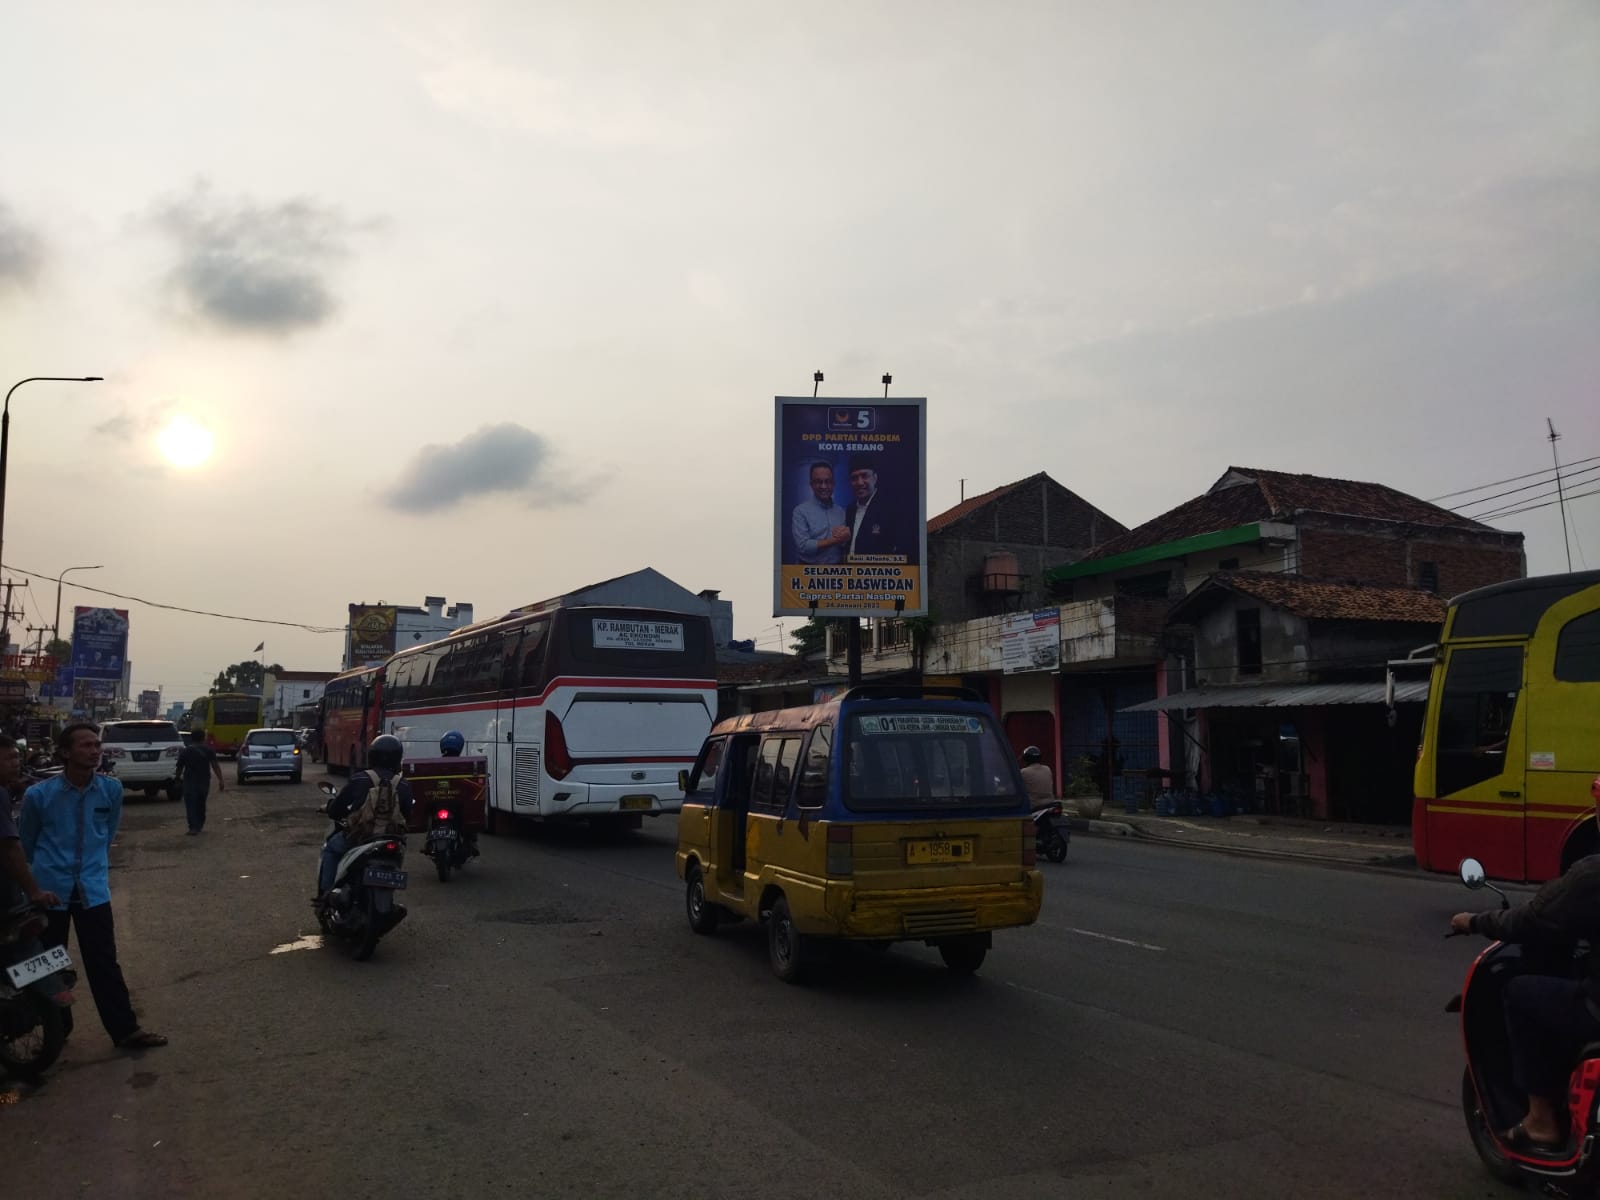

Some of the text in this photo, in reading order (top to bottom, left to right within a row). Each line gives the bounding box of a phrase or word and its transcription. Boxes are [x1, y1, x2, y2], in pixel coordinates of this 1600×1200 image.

[857, 410, 870, 429] 5
[802, 433, 901, 442] DPD PARTAI NASDEM
[818, 443, 884, 452] KOTA SERANG
[803, 567, 902, 577] SELAMAT DATANG
[791, 577, 914, 591] H. ANIES BASWEDAN
[799, 592, 833, 601] Capres
[835, 592, 864, 600] Partai
[597, 622, 609, 632] KP.
[610, 623, 650, 633] RAMBUTAN
[654, 625, 679, 635] MERAK
[881, 717, 897, 731] 01
[910, 844, 916, 857] A
[929, 842, 951, 856] 1958
[13, 968, 21, 978] A
[51, 949, 65, 959] CB
